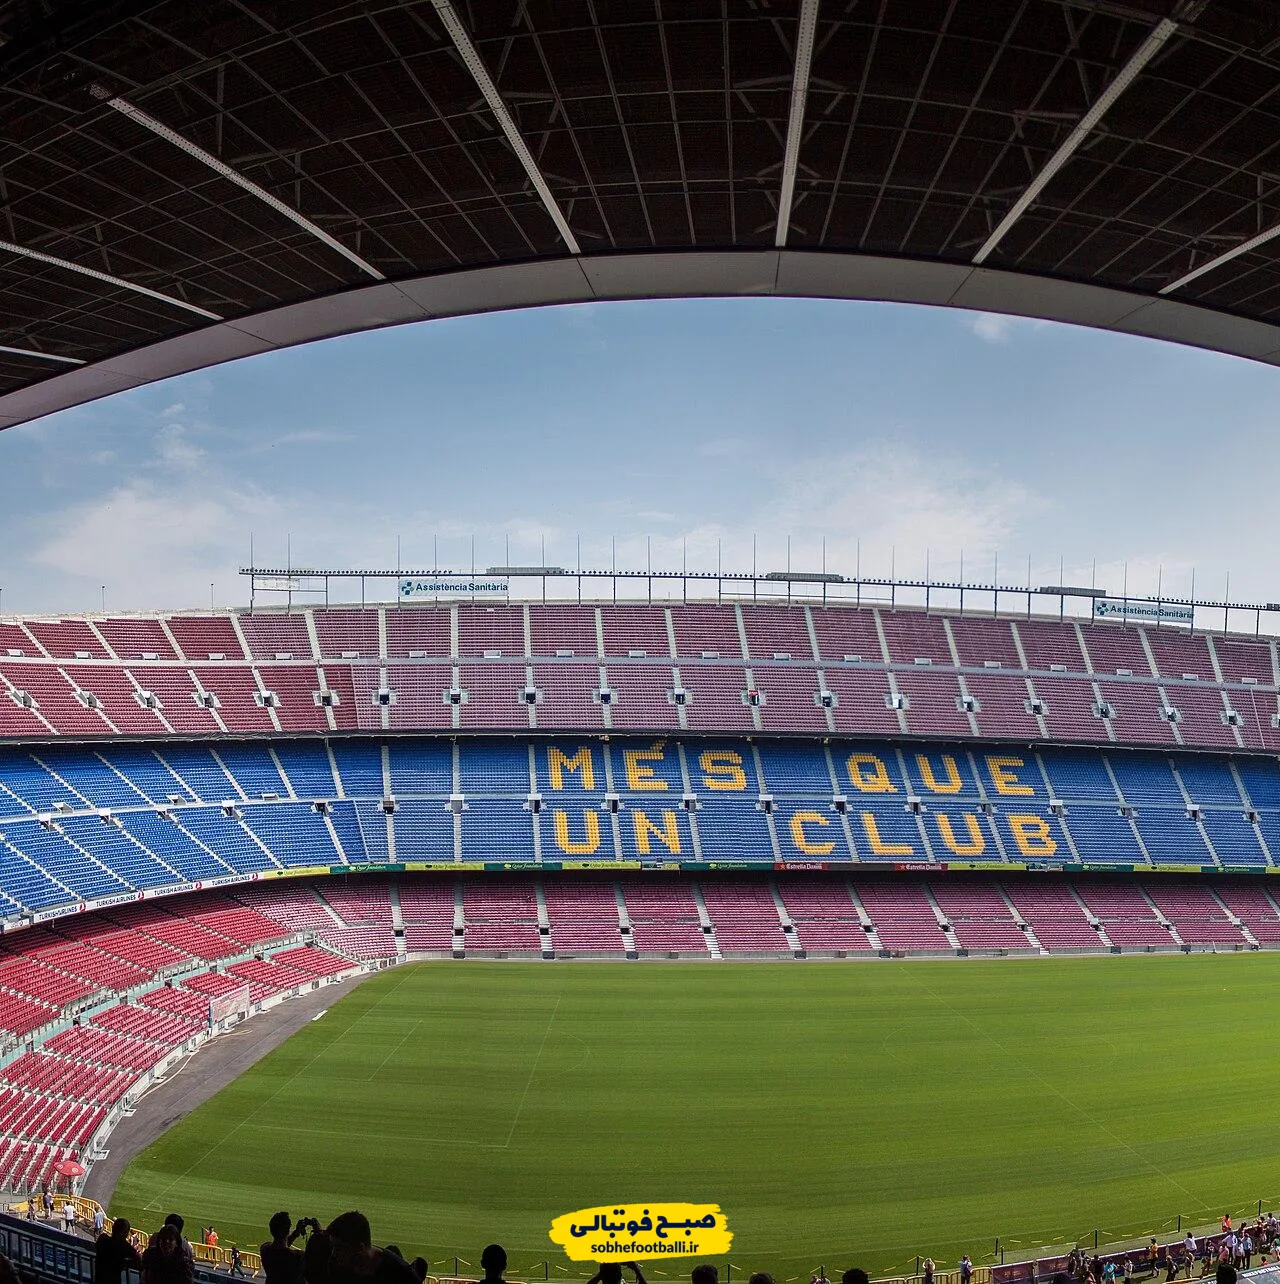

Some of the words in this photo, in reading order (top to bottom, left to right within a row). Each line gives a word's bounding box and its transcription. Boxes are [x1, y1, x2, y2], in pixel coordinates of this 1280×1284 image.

[415, 583, 468, 591] Assistència
[468, 583, 508, 591] Sanitària
[1110, 605, 1158, 616] Assistència
[547, 739, 747, 791] MÉS
[846, 753, 1034, 796] QUE
[554, 809, 681, 855] UN
[788, 810, 1058, 856] CLUB
[231, 875, 250, 883] AIRLINES
[154, 888, 174, 896] TURKISH
[174, 883, 194, 892] AIRLINES
[96, 898, 115, 908] TURKISH
[116, 894, 136, 903] AIRLINES
[39, 911, 59, 920] TURKISH
